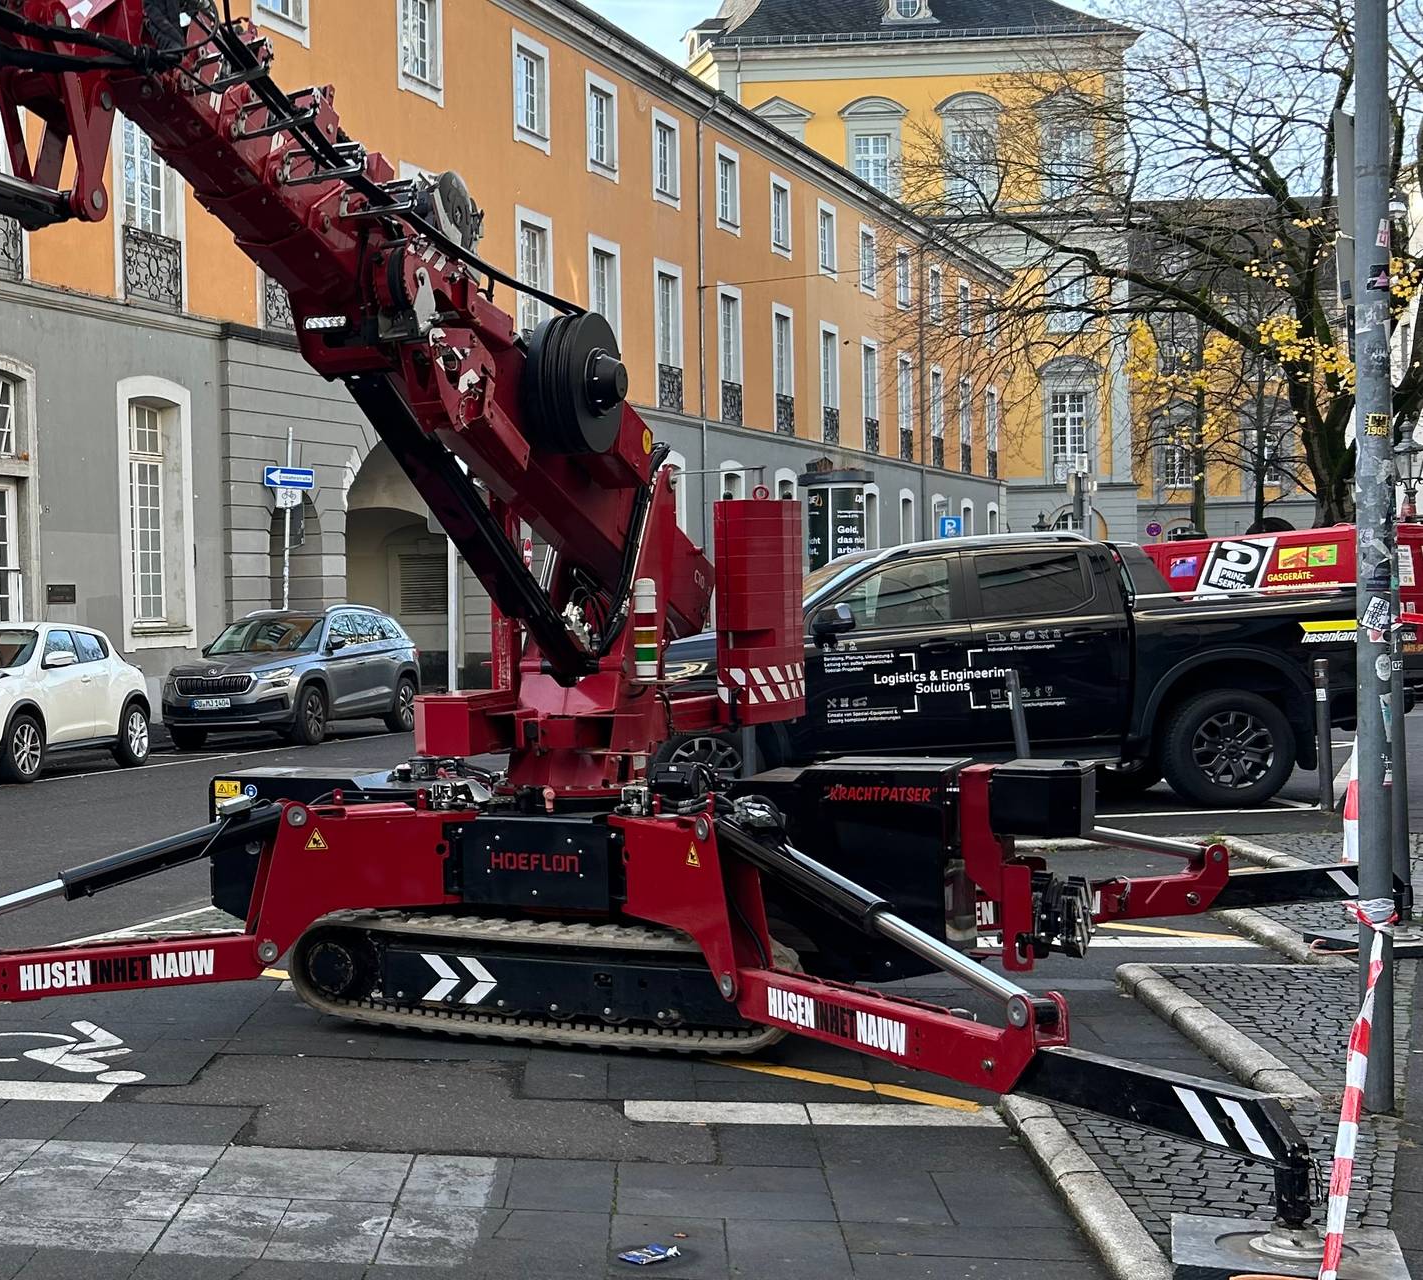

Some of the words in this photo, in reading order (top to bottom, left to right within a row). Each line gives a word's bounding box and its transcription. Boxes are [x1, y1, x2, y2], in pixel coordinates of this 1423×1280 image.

[1367, 426, 1387, 435] 1909
[837, 525, 859, 534] Geld,
[837, 536, 853, 544] das
[1220, 569, 1247, 583] PRINZ
[1267, 570, 1315, 582] GASGERÄTE-
[1301, 631, 1357, 643] hasenkam
[873, 672, 926, 686] Logistics
[929, 670, 939, 681] &
[941, 667, 1012, 682] Engineerin
[915, 682, 971, 694] Solutions
[490, 851, 579, 873] HOEFLON
